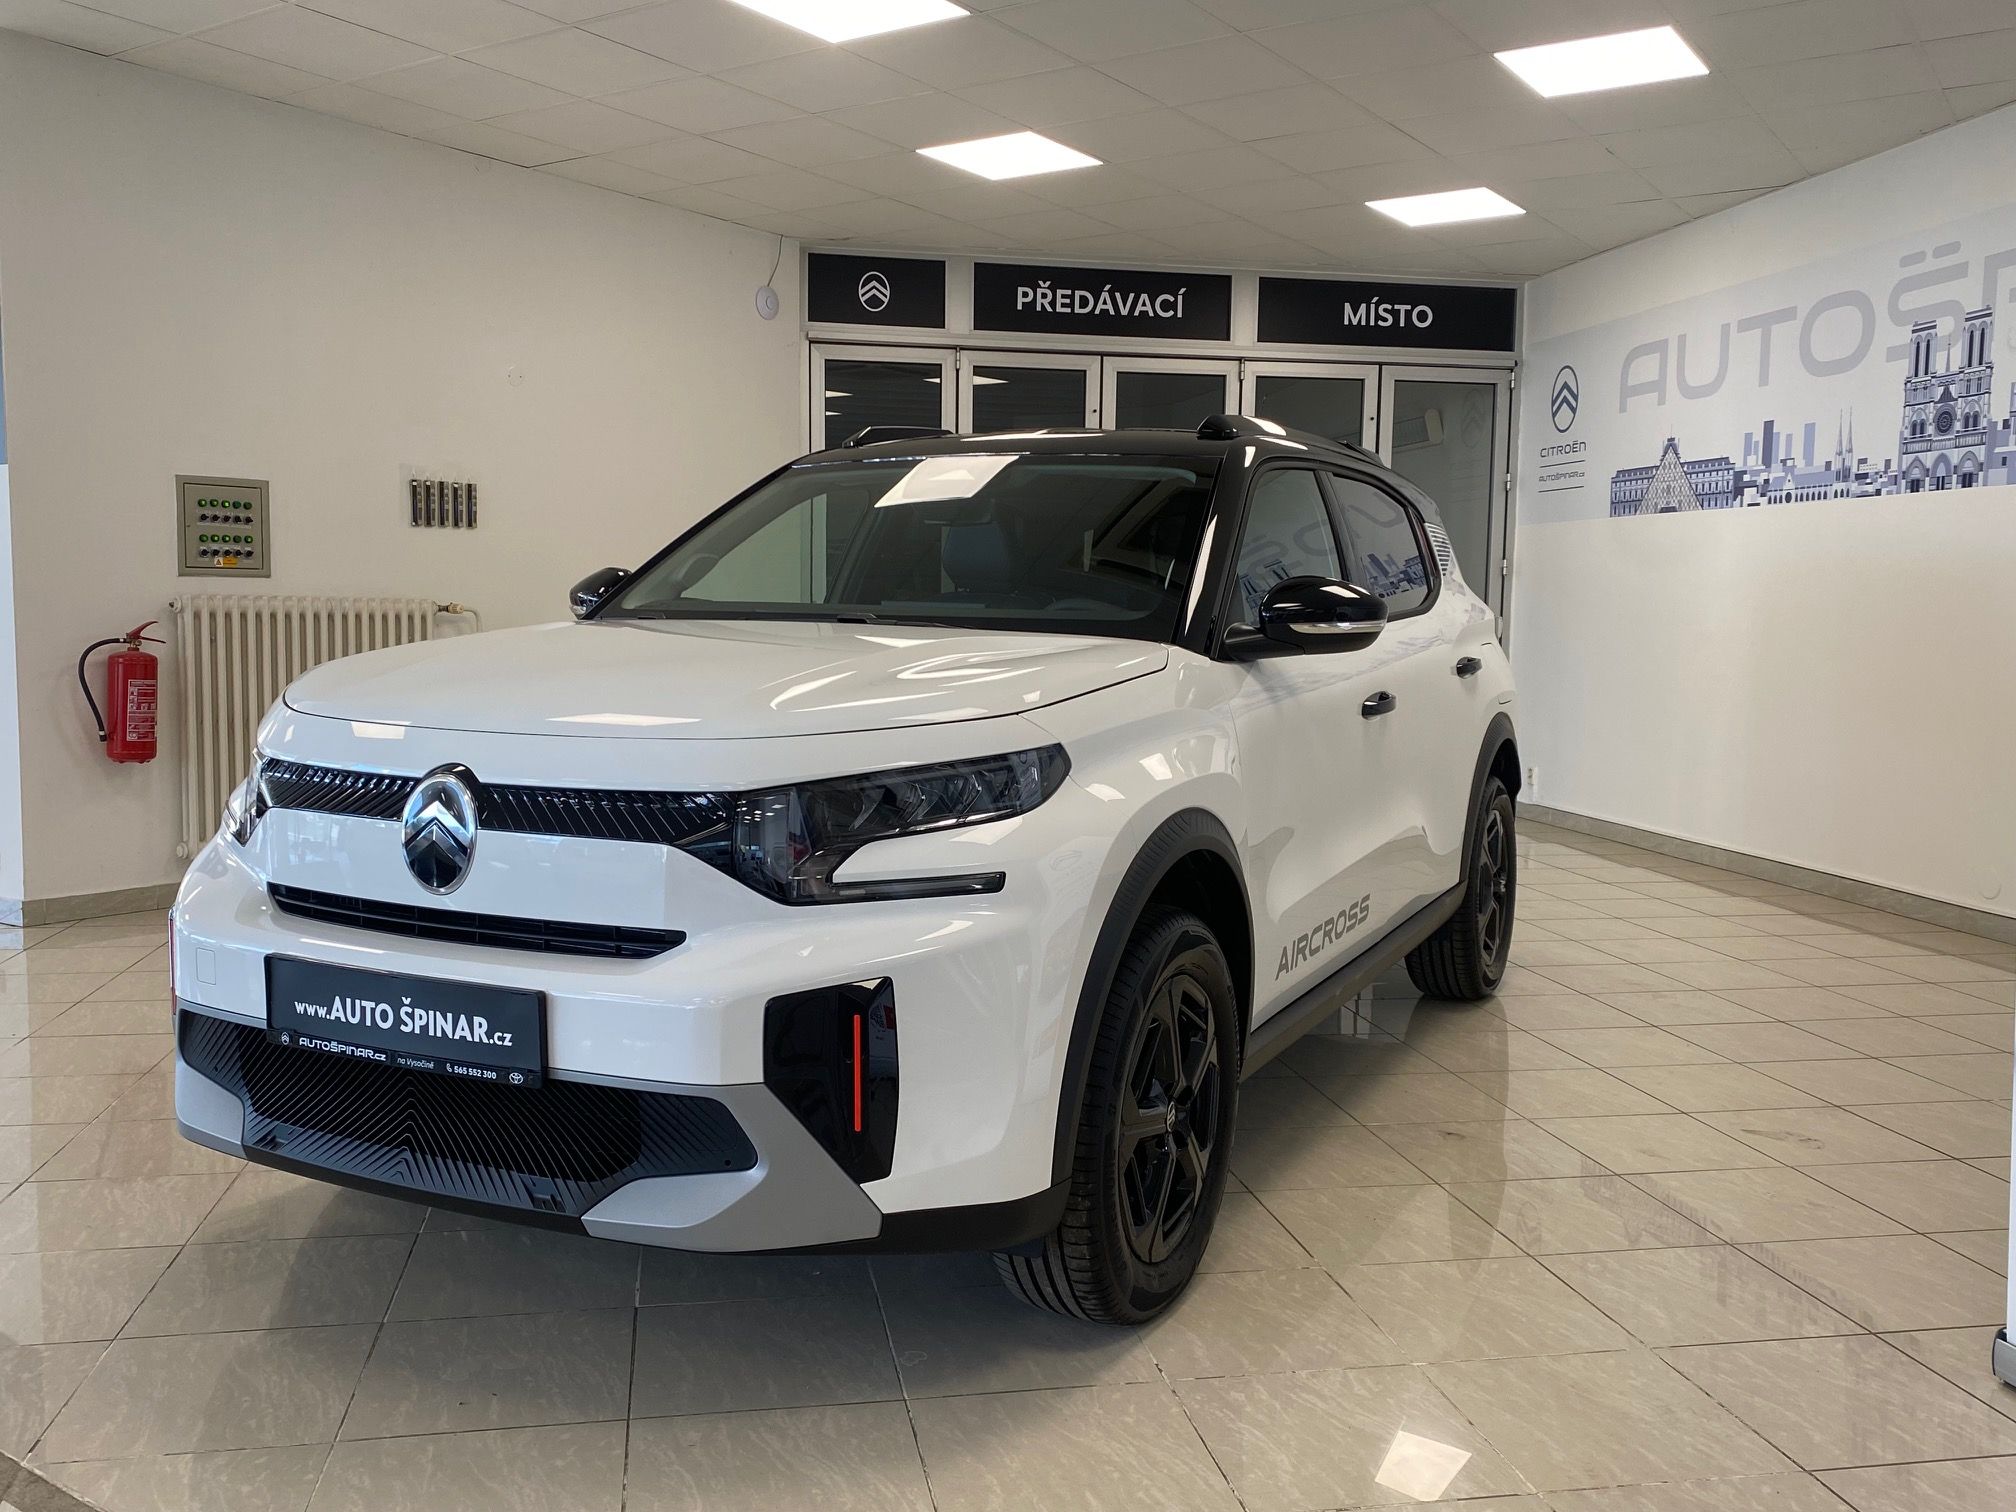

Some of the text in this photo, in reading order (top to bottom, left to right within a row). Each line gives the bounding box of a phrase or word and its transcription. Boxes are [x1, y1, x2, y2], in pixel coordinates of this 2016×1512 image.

[1016, 280, 1434, 328] PŘEDÁVACÍ MÍSTO
[1275, 893, 1371, 982] AIRCROSS
[294, 995, 513, 1047] www.AUTO ŠPINAR.cz
[454, 1065, 497, 1080] 565 552 300
